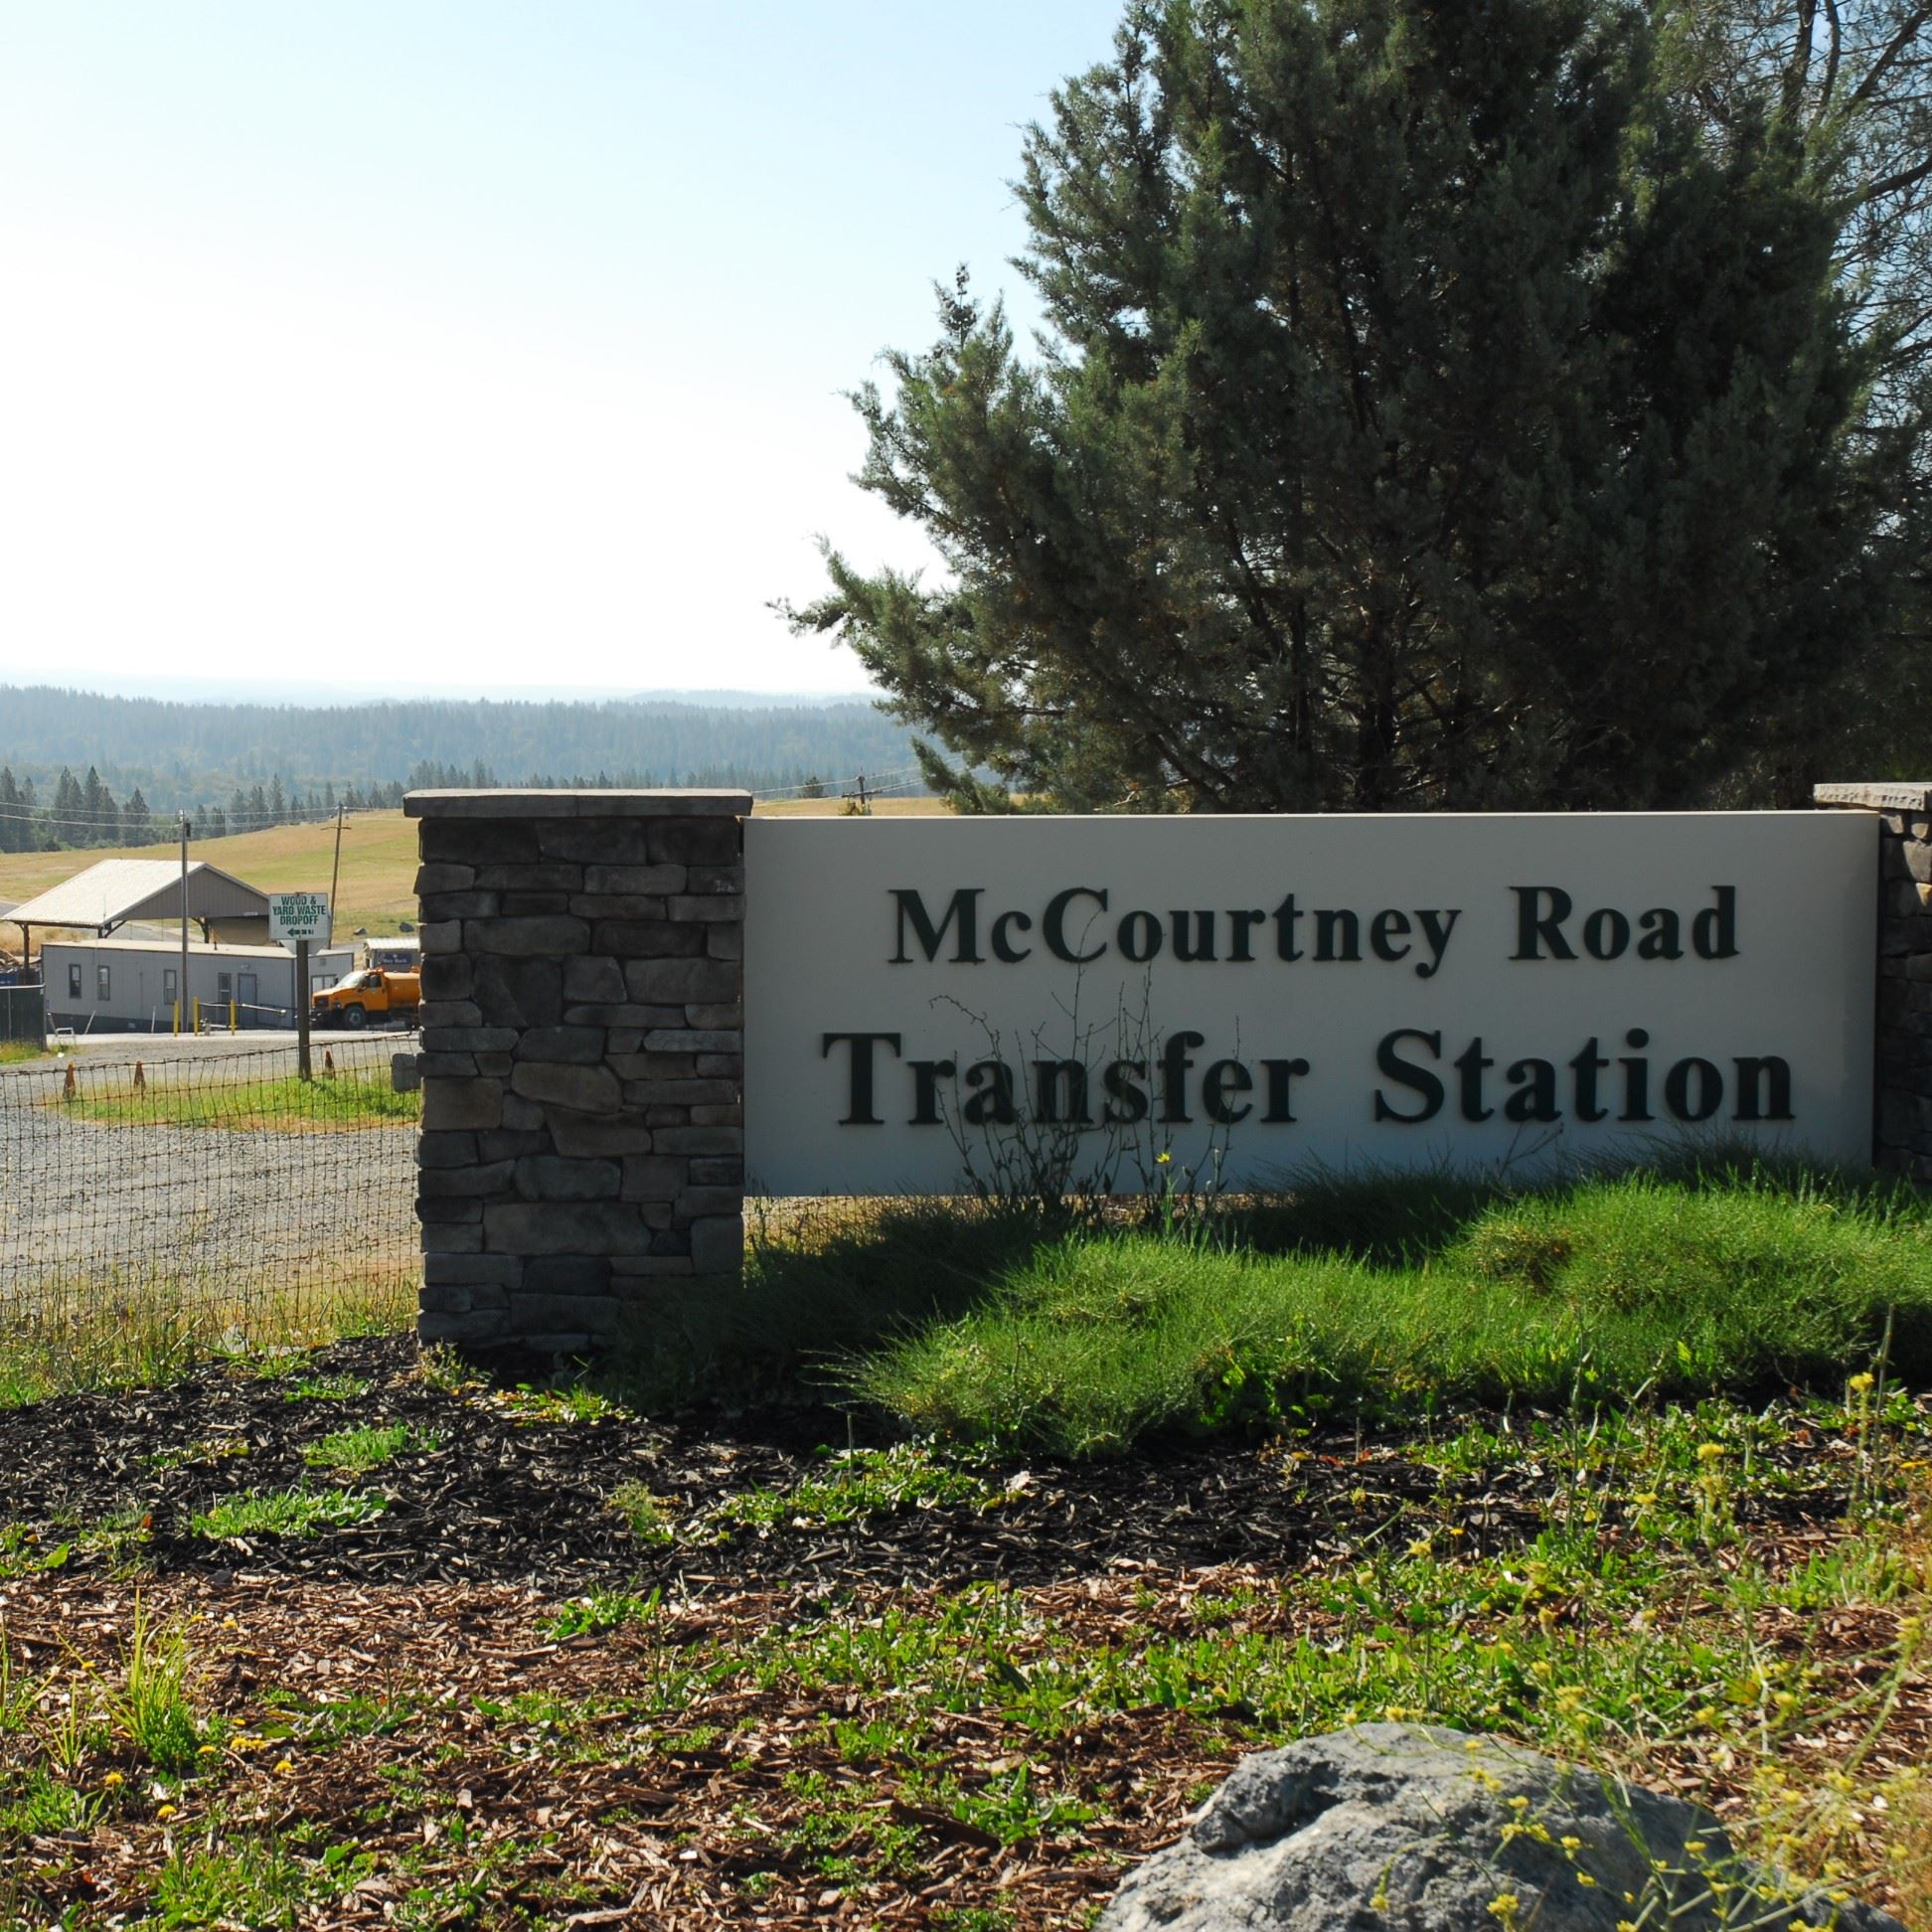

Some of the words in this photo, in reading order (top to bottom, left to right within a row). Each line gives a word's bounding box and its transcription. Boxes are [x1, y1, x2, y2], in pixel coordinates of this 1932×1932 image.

[281, 895, 307, 905] WOOD
[310, 895, 317, 905] &
[272, 905, 294, 915] YARD
[297, 905, 326, 915] WASTE
[280, 914, 318, 925] DROPOFF
[887, 886, 1462, 979] McCourtney
[1508, 885, 1739, 961] Road
[821, 1030, 1311, 1128] Transfer
[1371, 1028, 1799, 1128] Station
